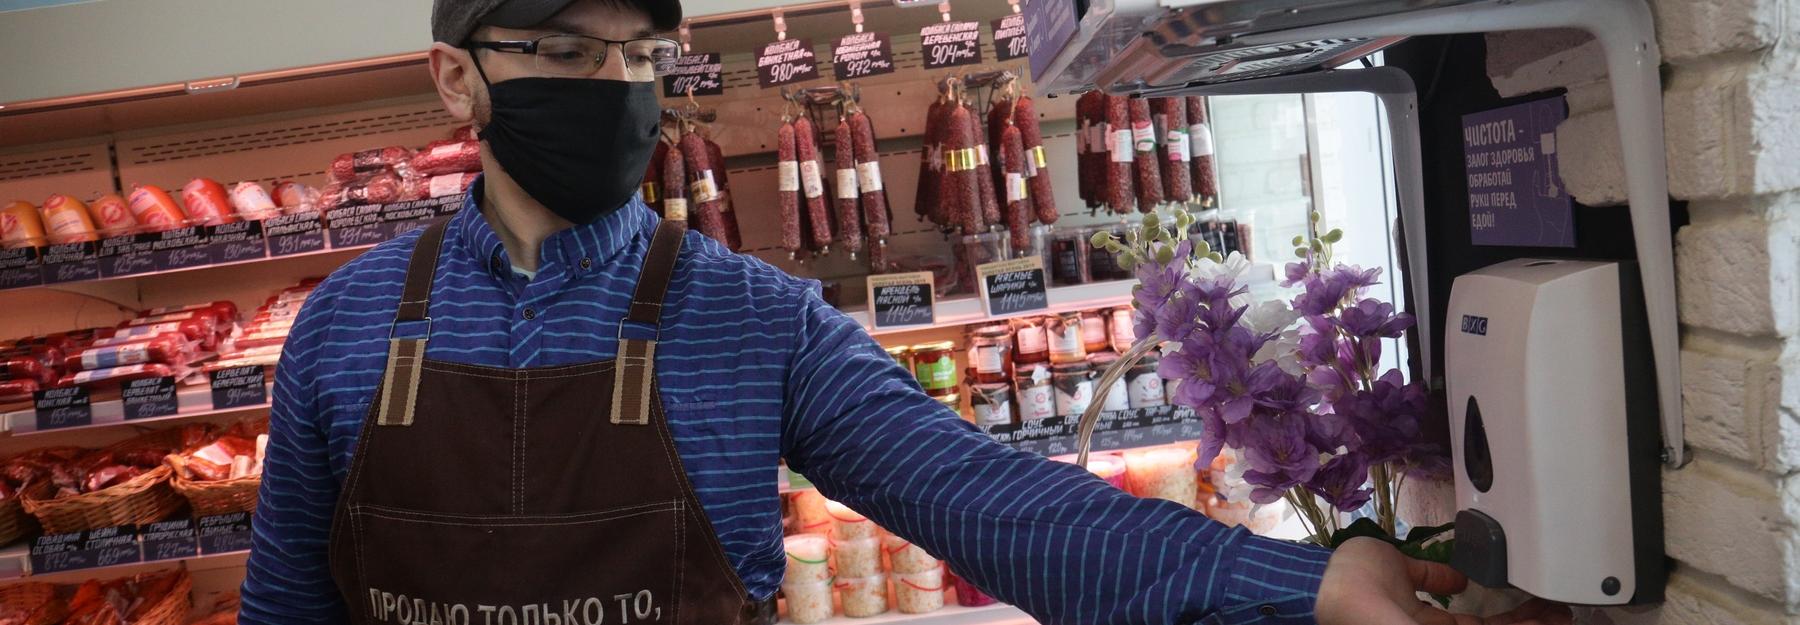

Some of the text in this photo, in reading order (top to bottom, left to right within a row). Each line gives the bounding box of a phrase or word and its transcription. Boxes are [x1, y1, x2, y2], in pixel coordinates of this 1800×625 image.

[922, 30, 980, 45] ДЕРЕВЕНСКАЯ
[1008, 36, 1028, 56] 107
[758, 48, 805, 67] БАНКЕТНАЯ
[764, 40, 800, 56] КОЛБАСА
[930, 44, 958, 65] 904
[675, 54, 709, 65] ОЛБАСА
[846, 59, 871, 77] 972
[770, 62, 793, 83] 980
[1465, 119, 1516, 147] ЧИСТОТА
[1467, 147, 1535, 168] ЗАЛОГ ЗДОРОВЬЯ
[1469, 168, 1512, 188] ОБРАБОТАЙ
[1471, 191, 1517, 209] РУКИ ПЕРЕД
[1472, 212, 1495, 230] ЕДОЙ!
[278, 234, 300, 255] 931
[338, 227, 362, 246] 931
[994, 270, 1034, 284] МЯСНЫЕ
[1000, 291, 1028, 311] 1145
[886, 304, 917, 323] 1145
[1462, 315, 1487, 335] BXG
[1118, 408, 1140, 420] СОУС
[1012, 421, 1063, 441] ГОРЧИЧНЫЙ
[1022, 418, 1045, 430] СОУС
[370, 588, 661, 625] ПРОДАЮ ТОЛЬКО ТО,
